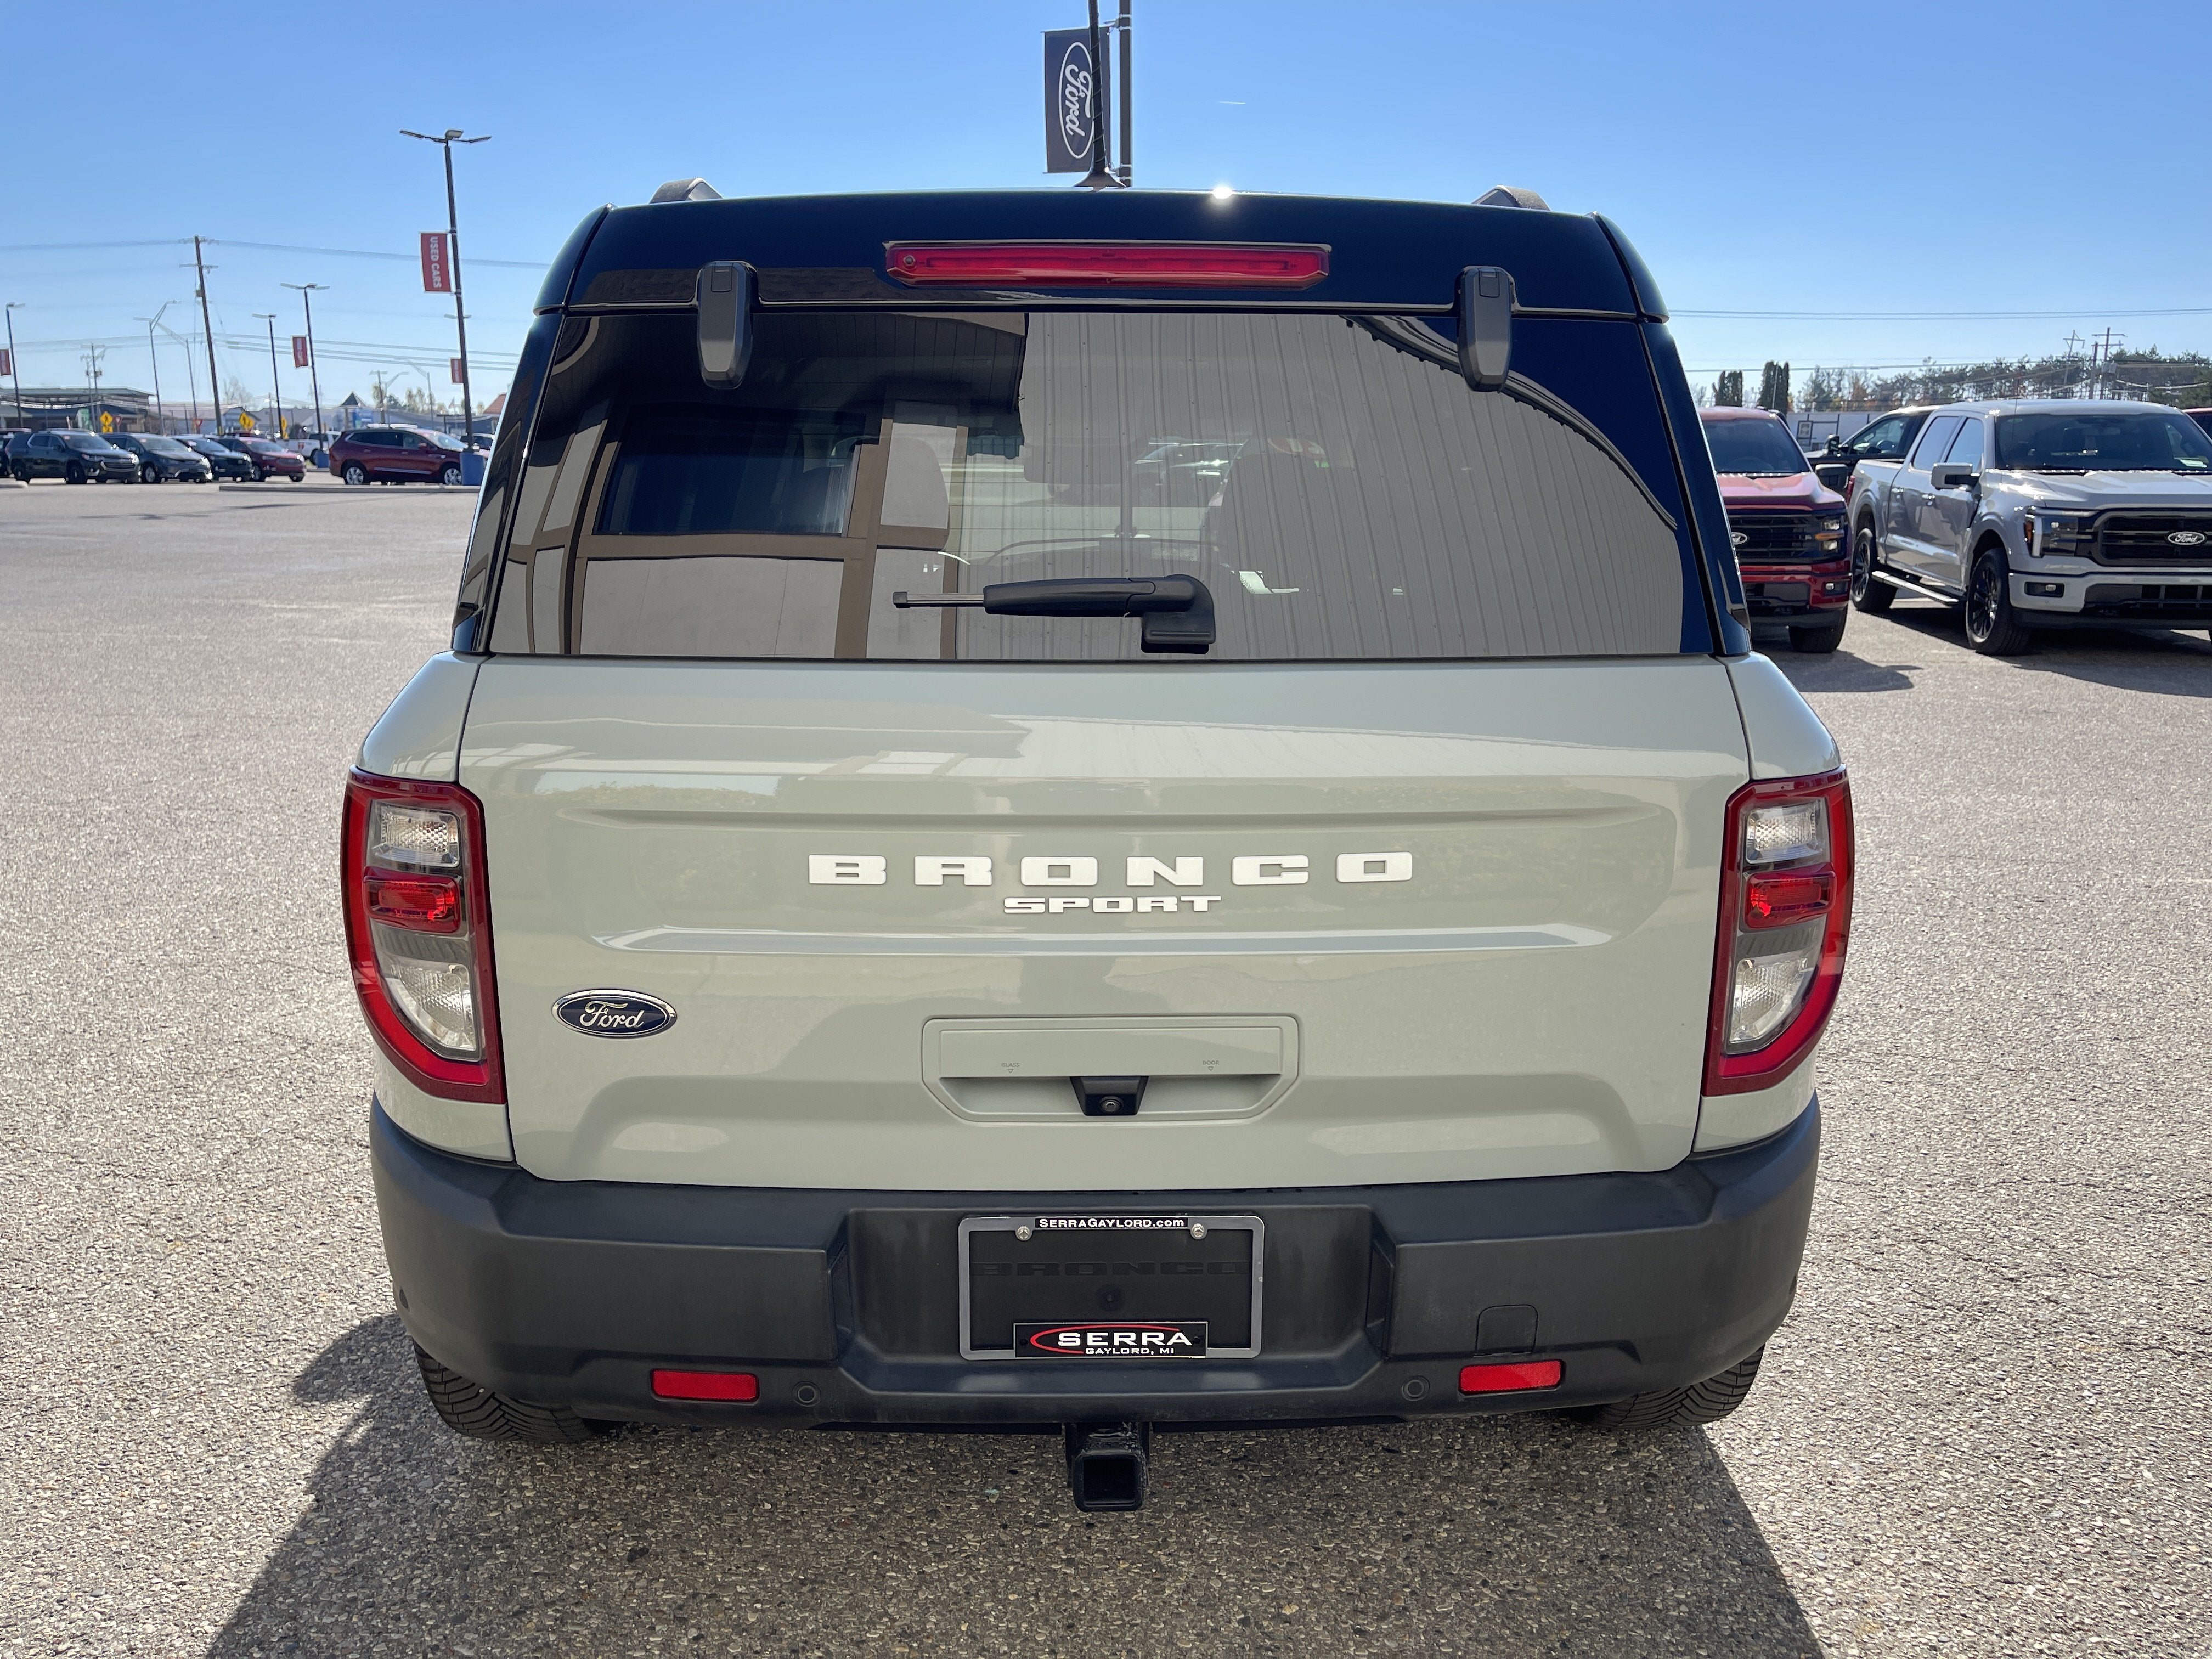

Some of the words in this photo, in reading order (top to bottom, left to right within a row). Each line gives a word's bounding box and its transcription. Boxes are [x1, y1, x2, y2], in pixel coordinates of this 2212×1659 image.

[1064, 64, 1092, 137] Ford
[430, 236, 439, 262] USED
[431, 263, 442, 289] CARS
[2175, 533, 2198, 543] Ford
[808, 851, 1413, 887] BRONCO
[1003, 895, 1222, 913] SPORT
[579, 1000, 645, 1029] Ford
[1039, 1217, 1185, 1228] SERRAGAYLORD.com
[972, 1261, 1251, 1276] BRONCO
[1057, 1331, 1192, 1347] SERRA
[1085, 1347, 1155, 1356] GAYLORD,
